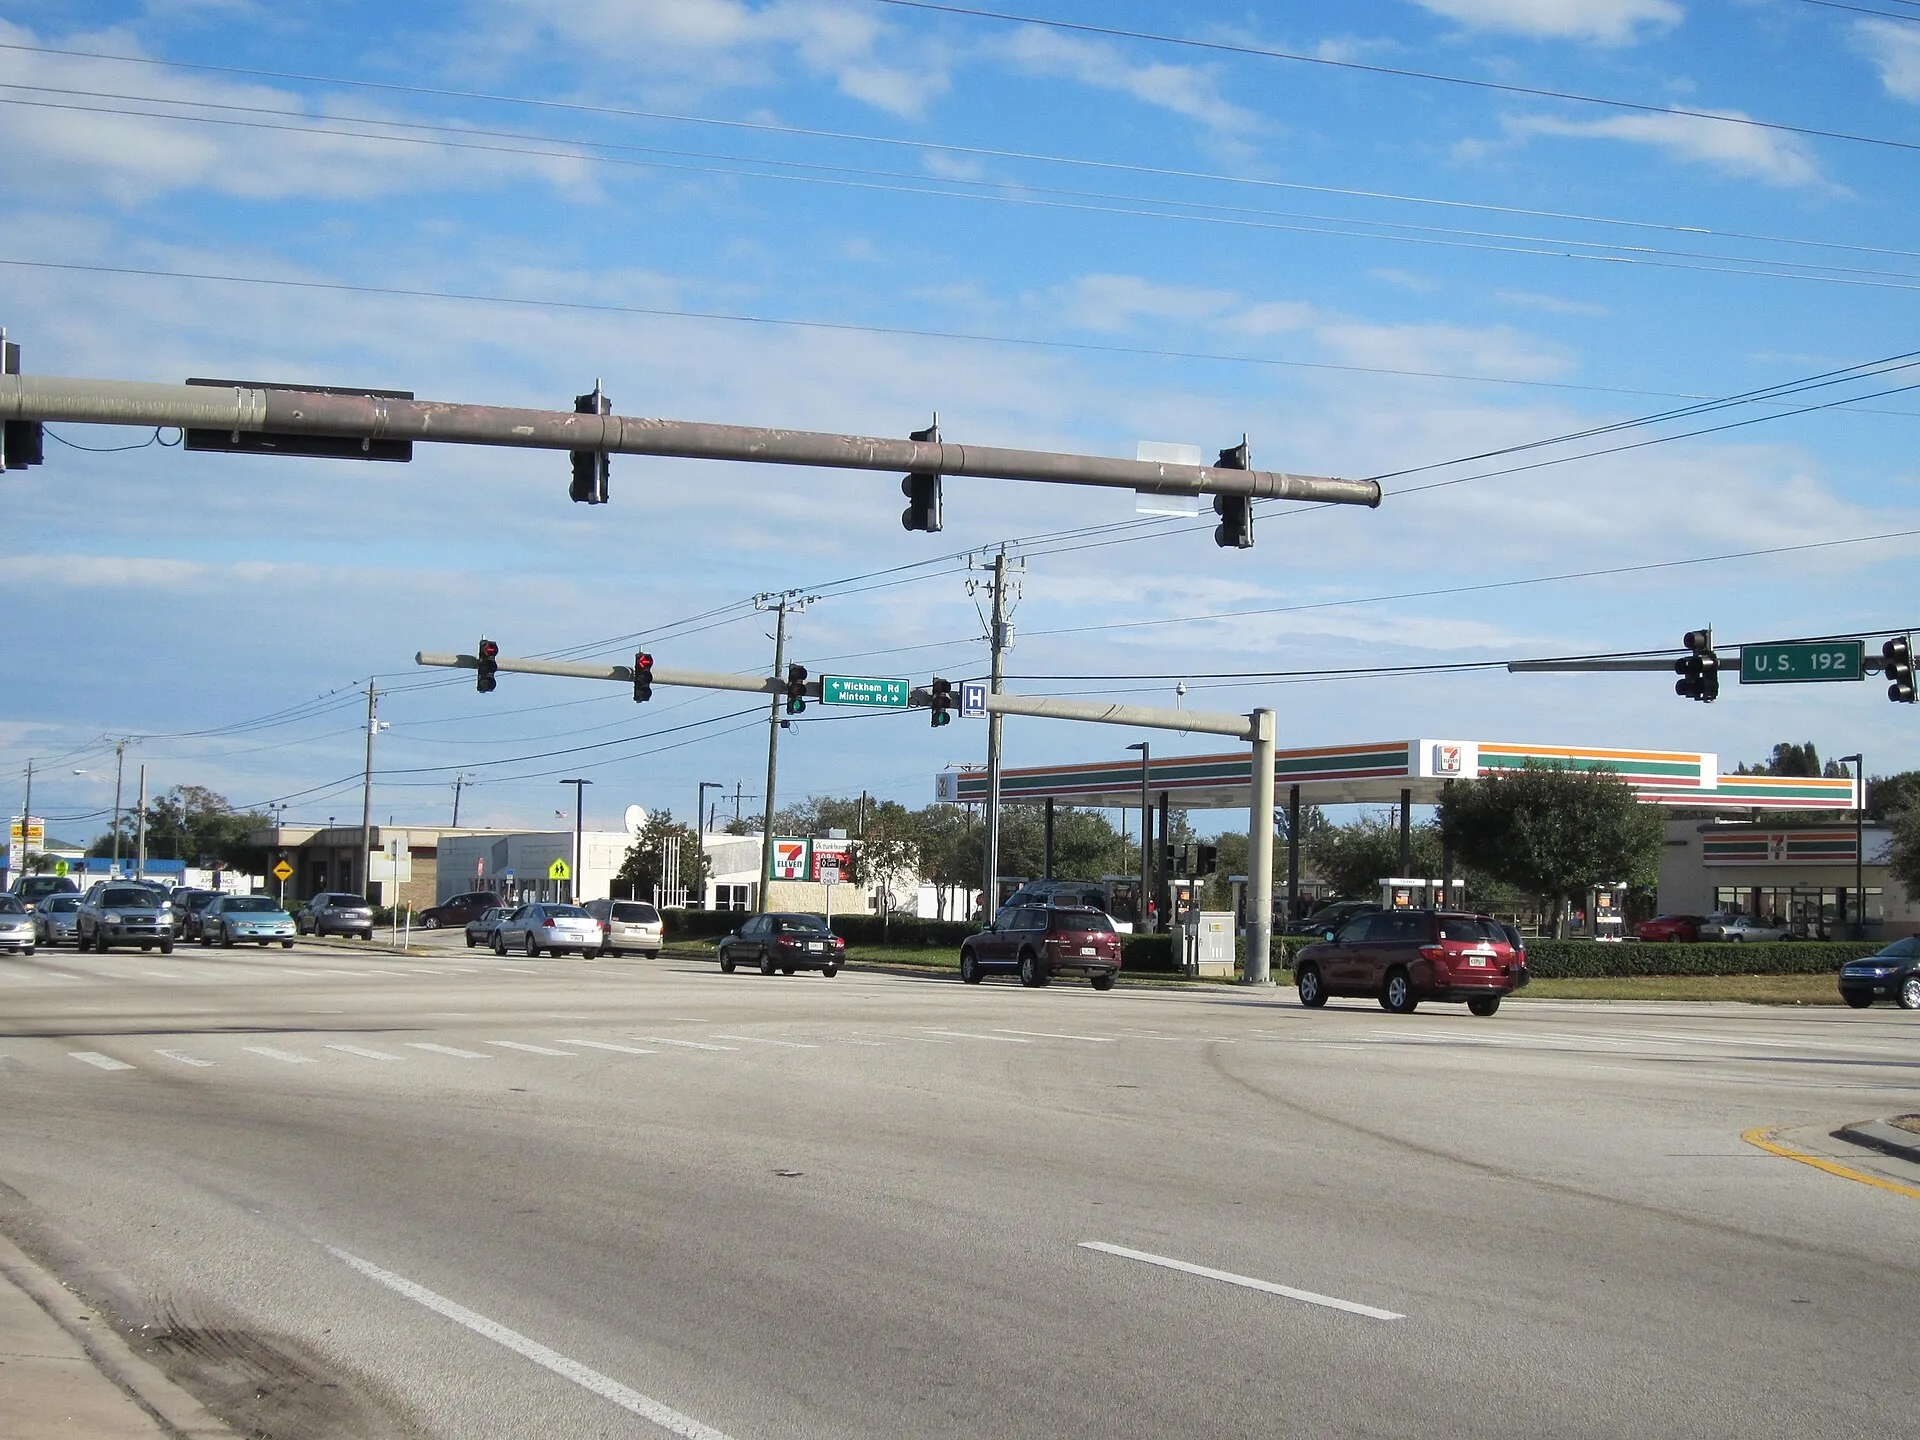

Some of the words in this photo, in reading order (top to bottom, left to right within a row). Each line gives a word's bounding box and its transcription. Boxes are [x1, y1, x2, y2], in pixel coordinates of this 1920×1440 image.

[1754, 654, 1796, 672] U.S.
[1810, 652, 1847, 670] 192
[843, 681, 882, 692] Wickham
[887, 684, 900, 693] Rd
[838, 692, 870, 702] Minton
[875, 694, 888, 702] Rd
[969, 688, 982, 707] H
[778, 844, 802, 878] 7
